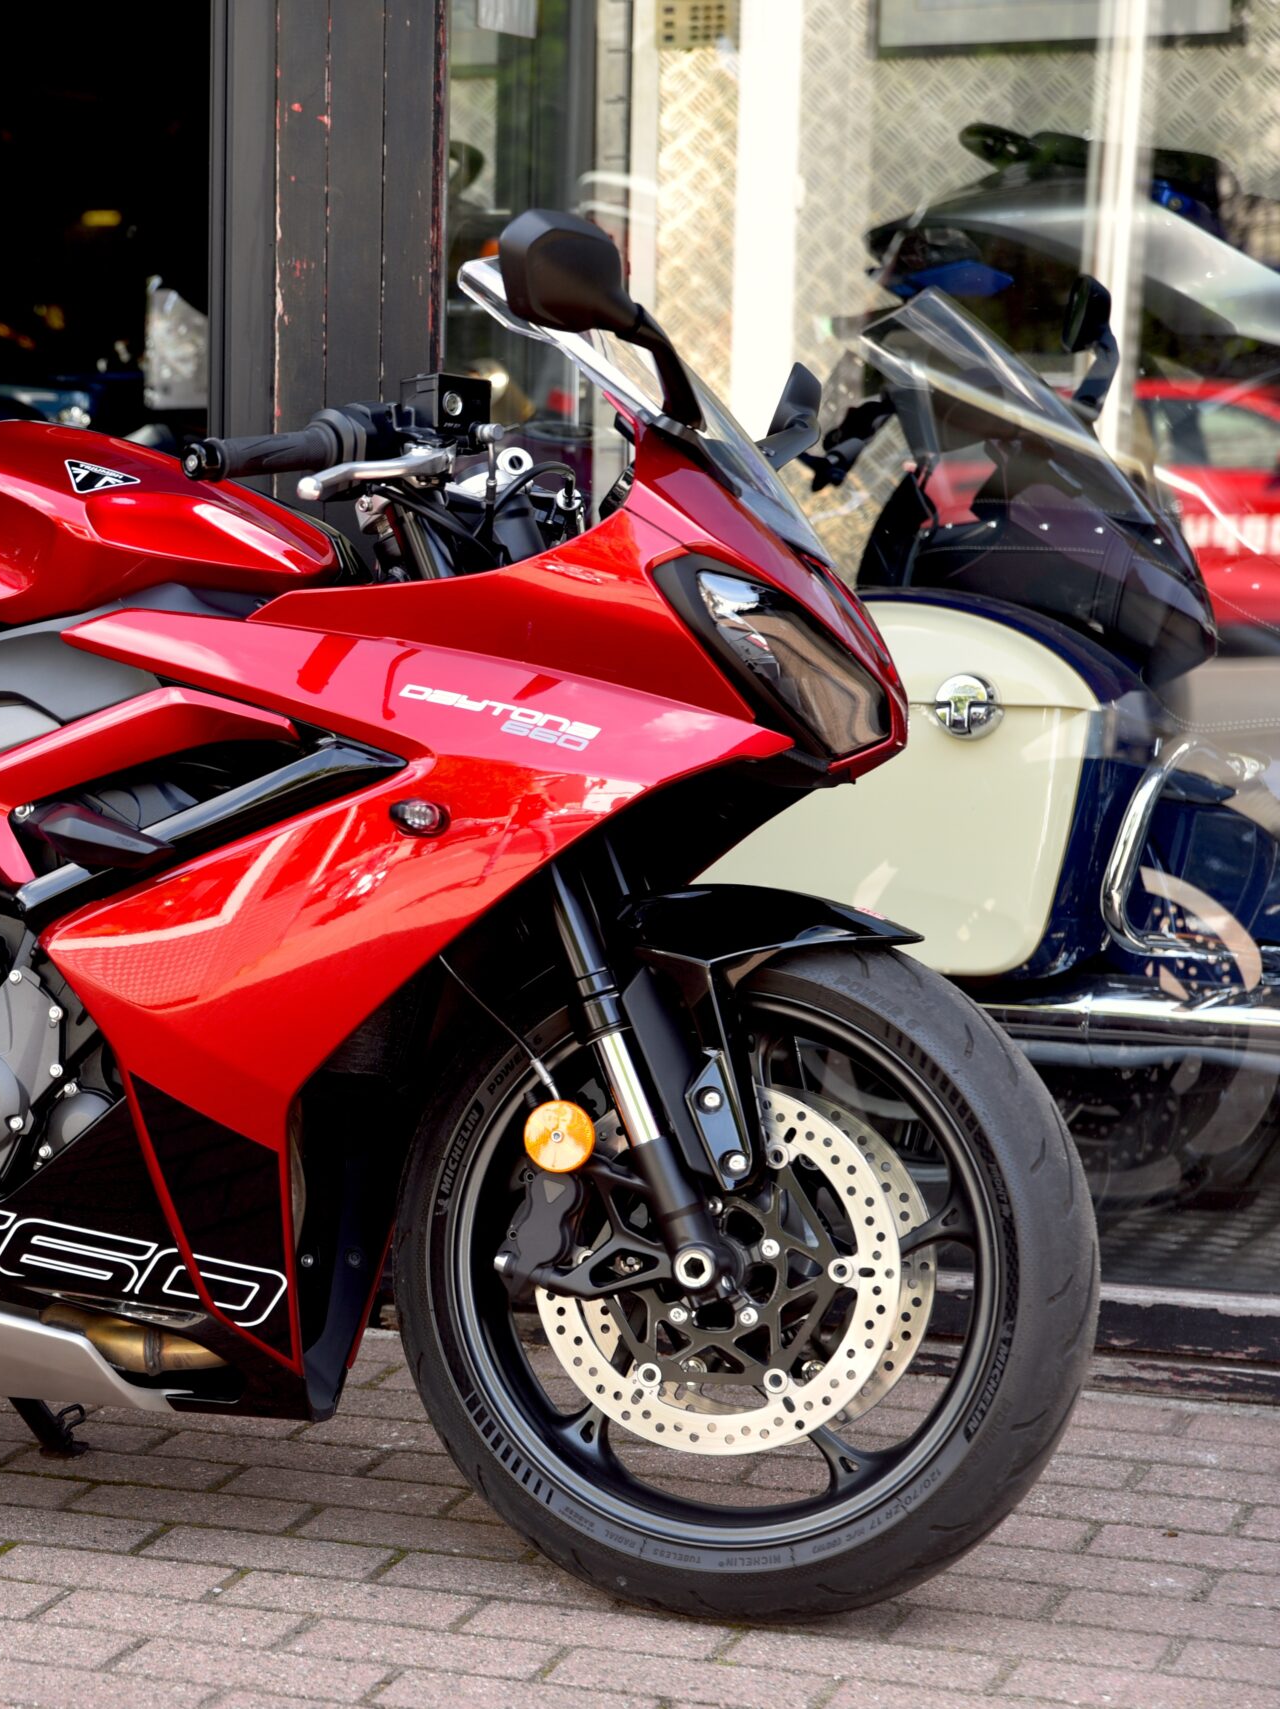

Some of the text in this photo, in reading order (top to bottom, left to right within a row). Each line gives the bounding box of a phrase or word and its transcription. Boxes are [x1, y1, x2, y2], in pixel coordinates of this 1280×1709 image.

[80, 463, 124, 479] TRIUMPH
[500, 719, 590, 752] 660
[833, 975, 905, 1018] POWER
[440, 1108, 480, 1195] MICHELIN
[532, 1034, 544, 1046] 6
[966, 1343, 1009, 1435] MICHELIN
[870, 1514, 883, 1531] 17
[604, 1529, 636, 1549] RADIAL
[652, 1547, 702, 1564] TUBELESS
